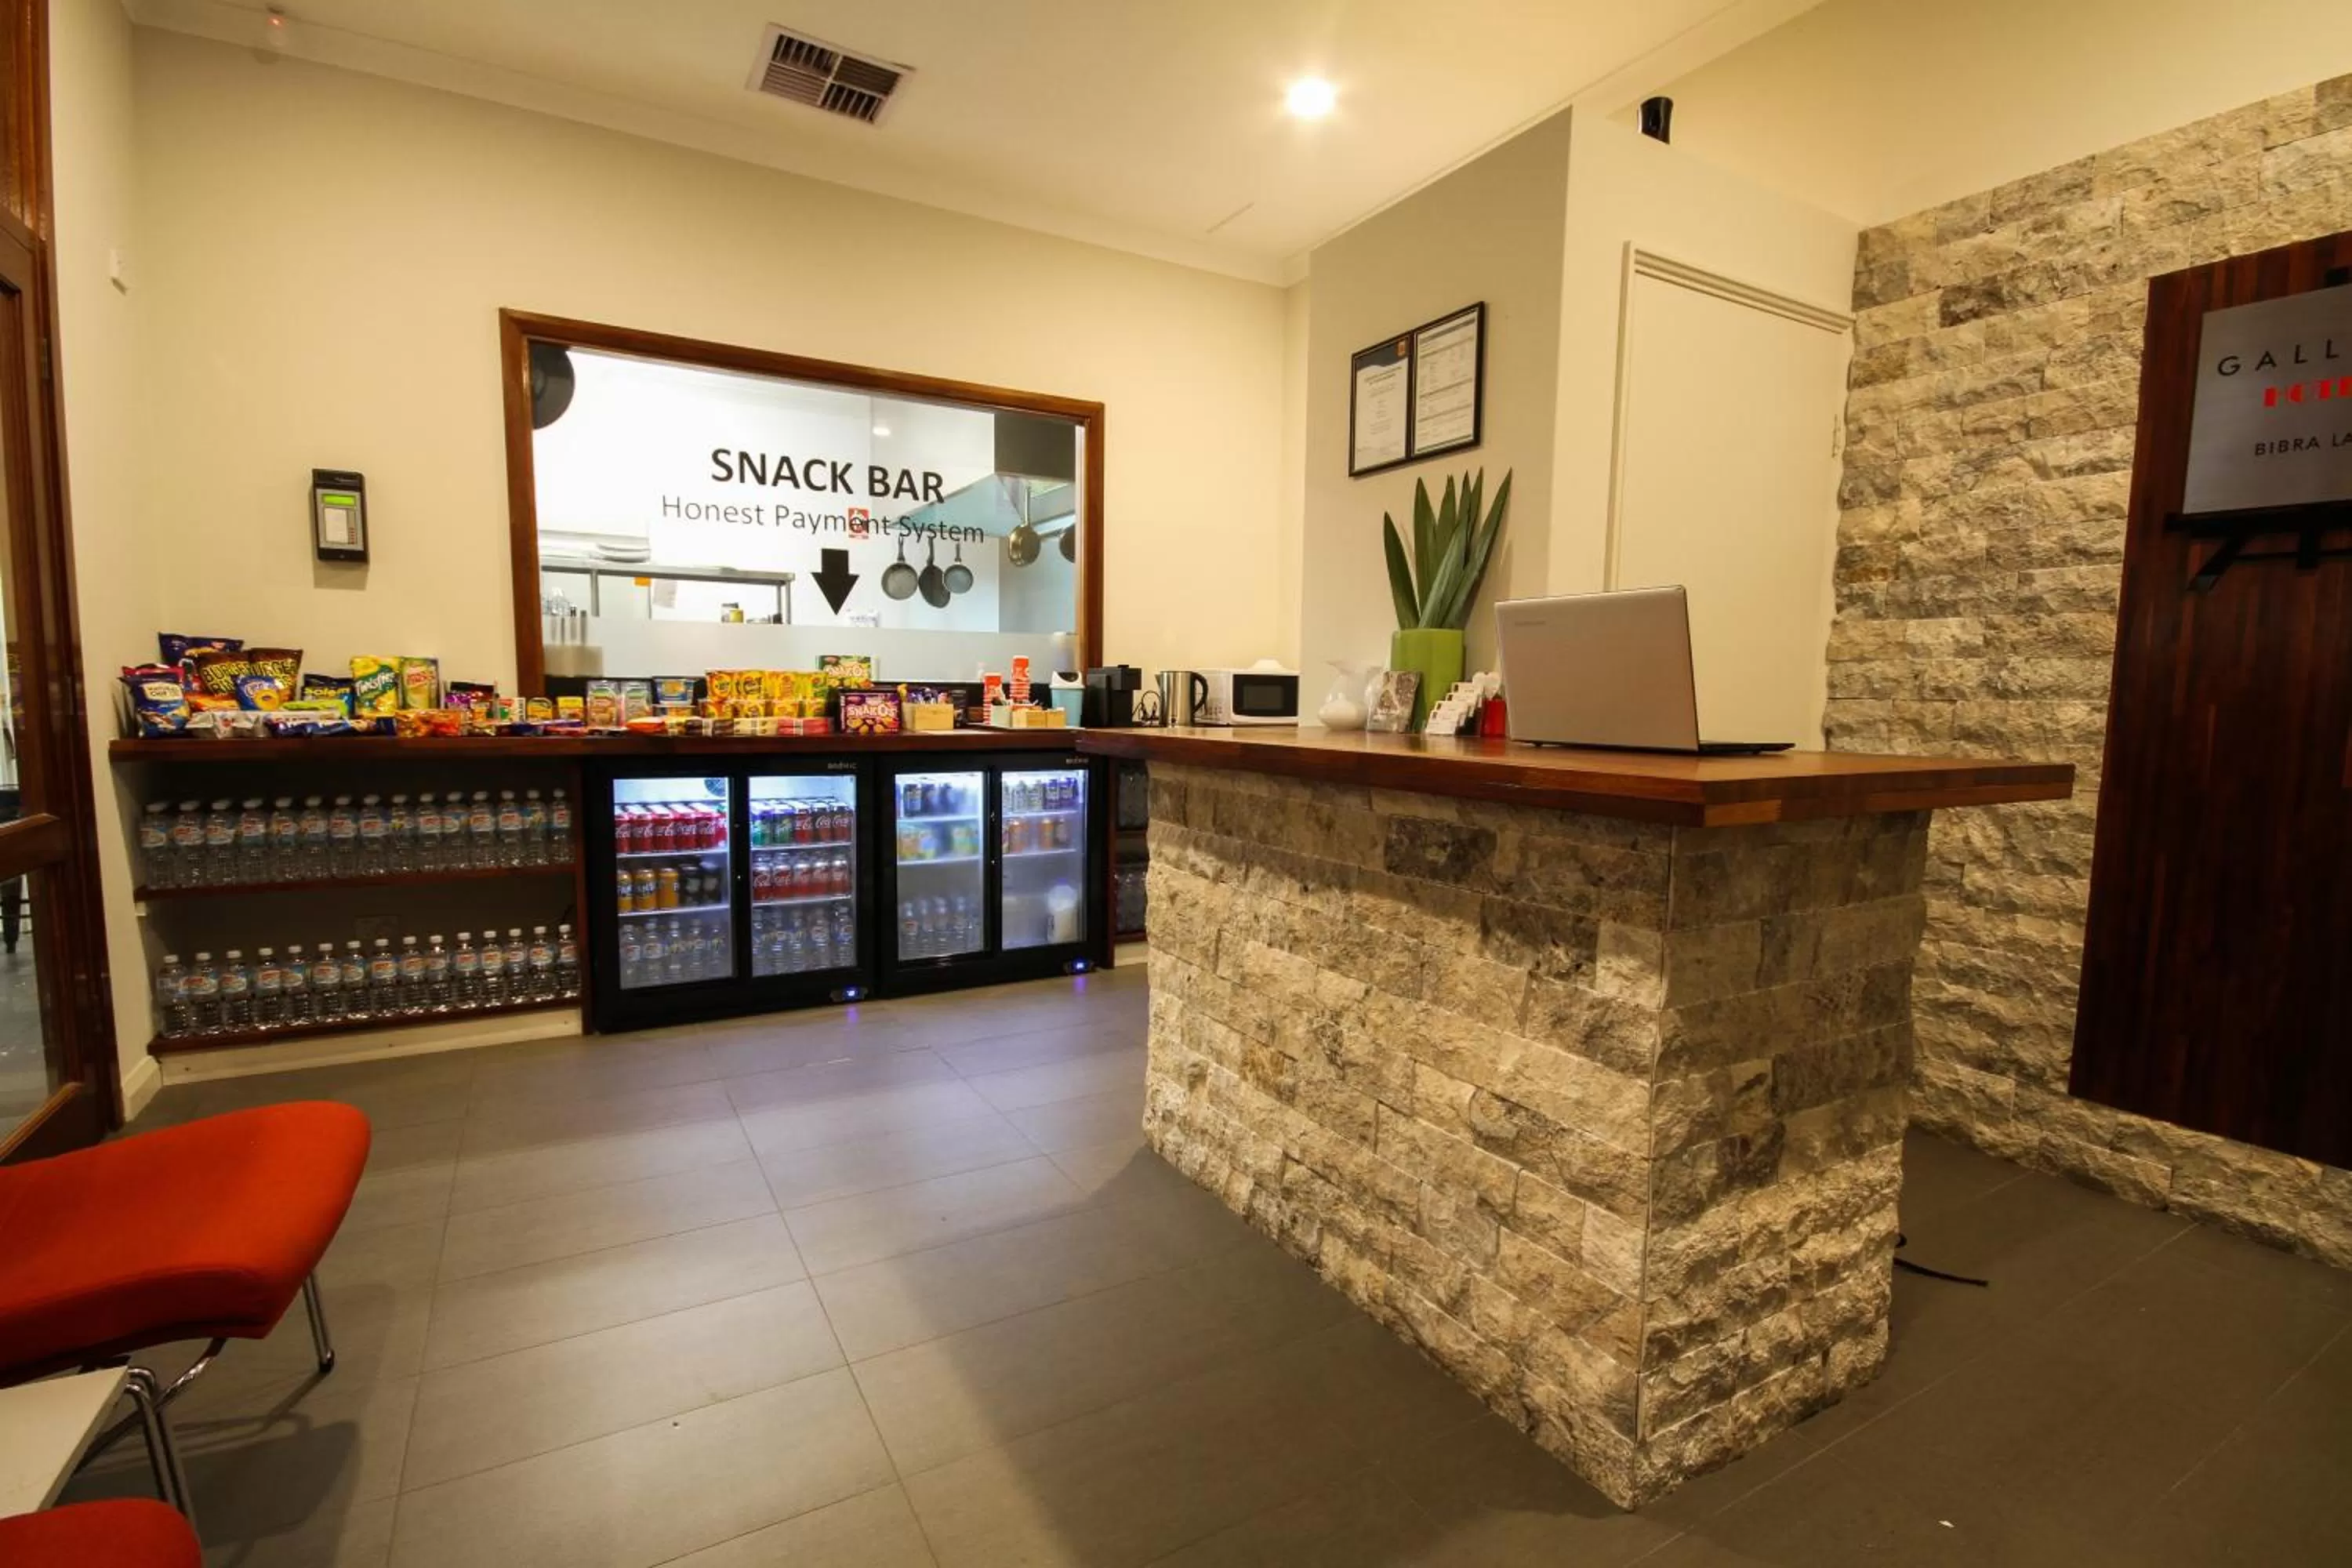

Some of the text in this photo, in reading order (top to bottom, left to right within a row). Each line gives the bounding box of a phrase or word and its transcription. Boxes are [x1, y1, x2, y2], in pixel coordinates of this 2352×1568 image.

[2216, 338, 2340, 377] GALL
[2254, 436, 2321, 456] BIBRA
[710, 448, 946, 503] SNACK BAR
[662, 495, 985, 544] Honest Payment System
